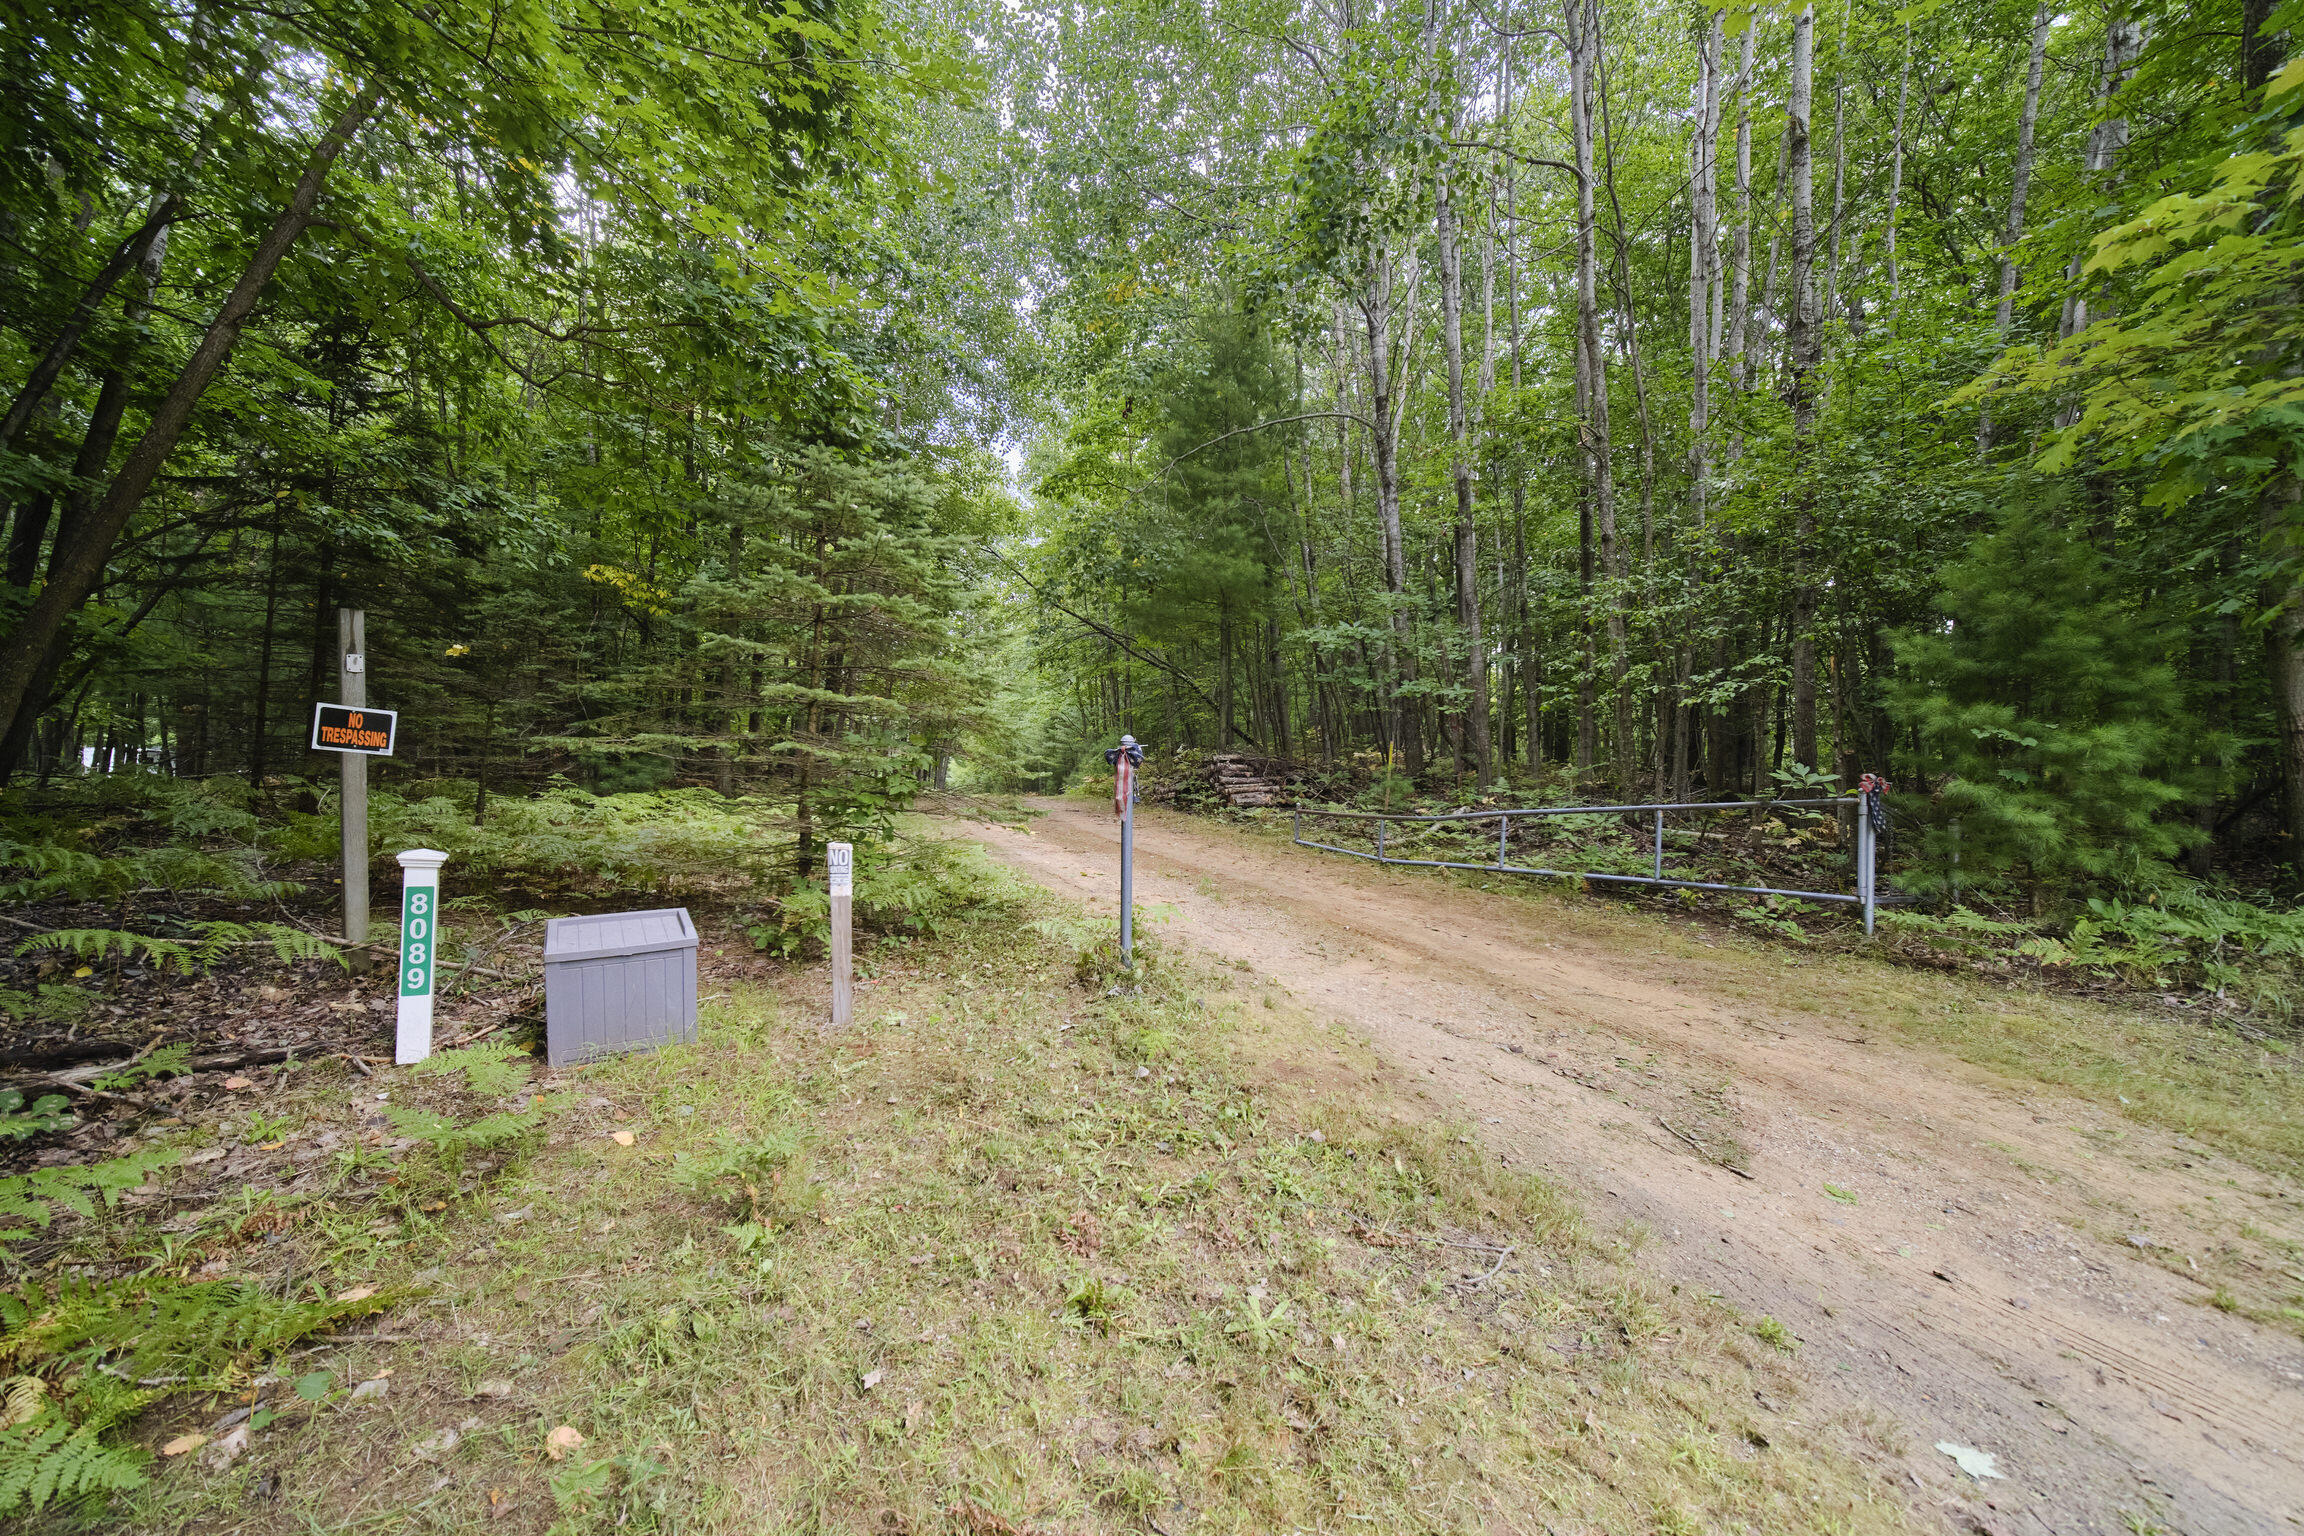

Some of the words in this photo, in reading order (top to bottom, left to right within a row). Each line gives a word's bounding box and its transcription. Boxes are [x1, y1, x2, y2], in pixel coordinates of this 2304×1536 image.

[348, 713, 364, 729] NO
[321, 726, 387, 748] TRESPASSING
[829, 849, 849, 866] NO
[407, 893, 428, 989] 8089
